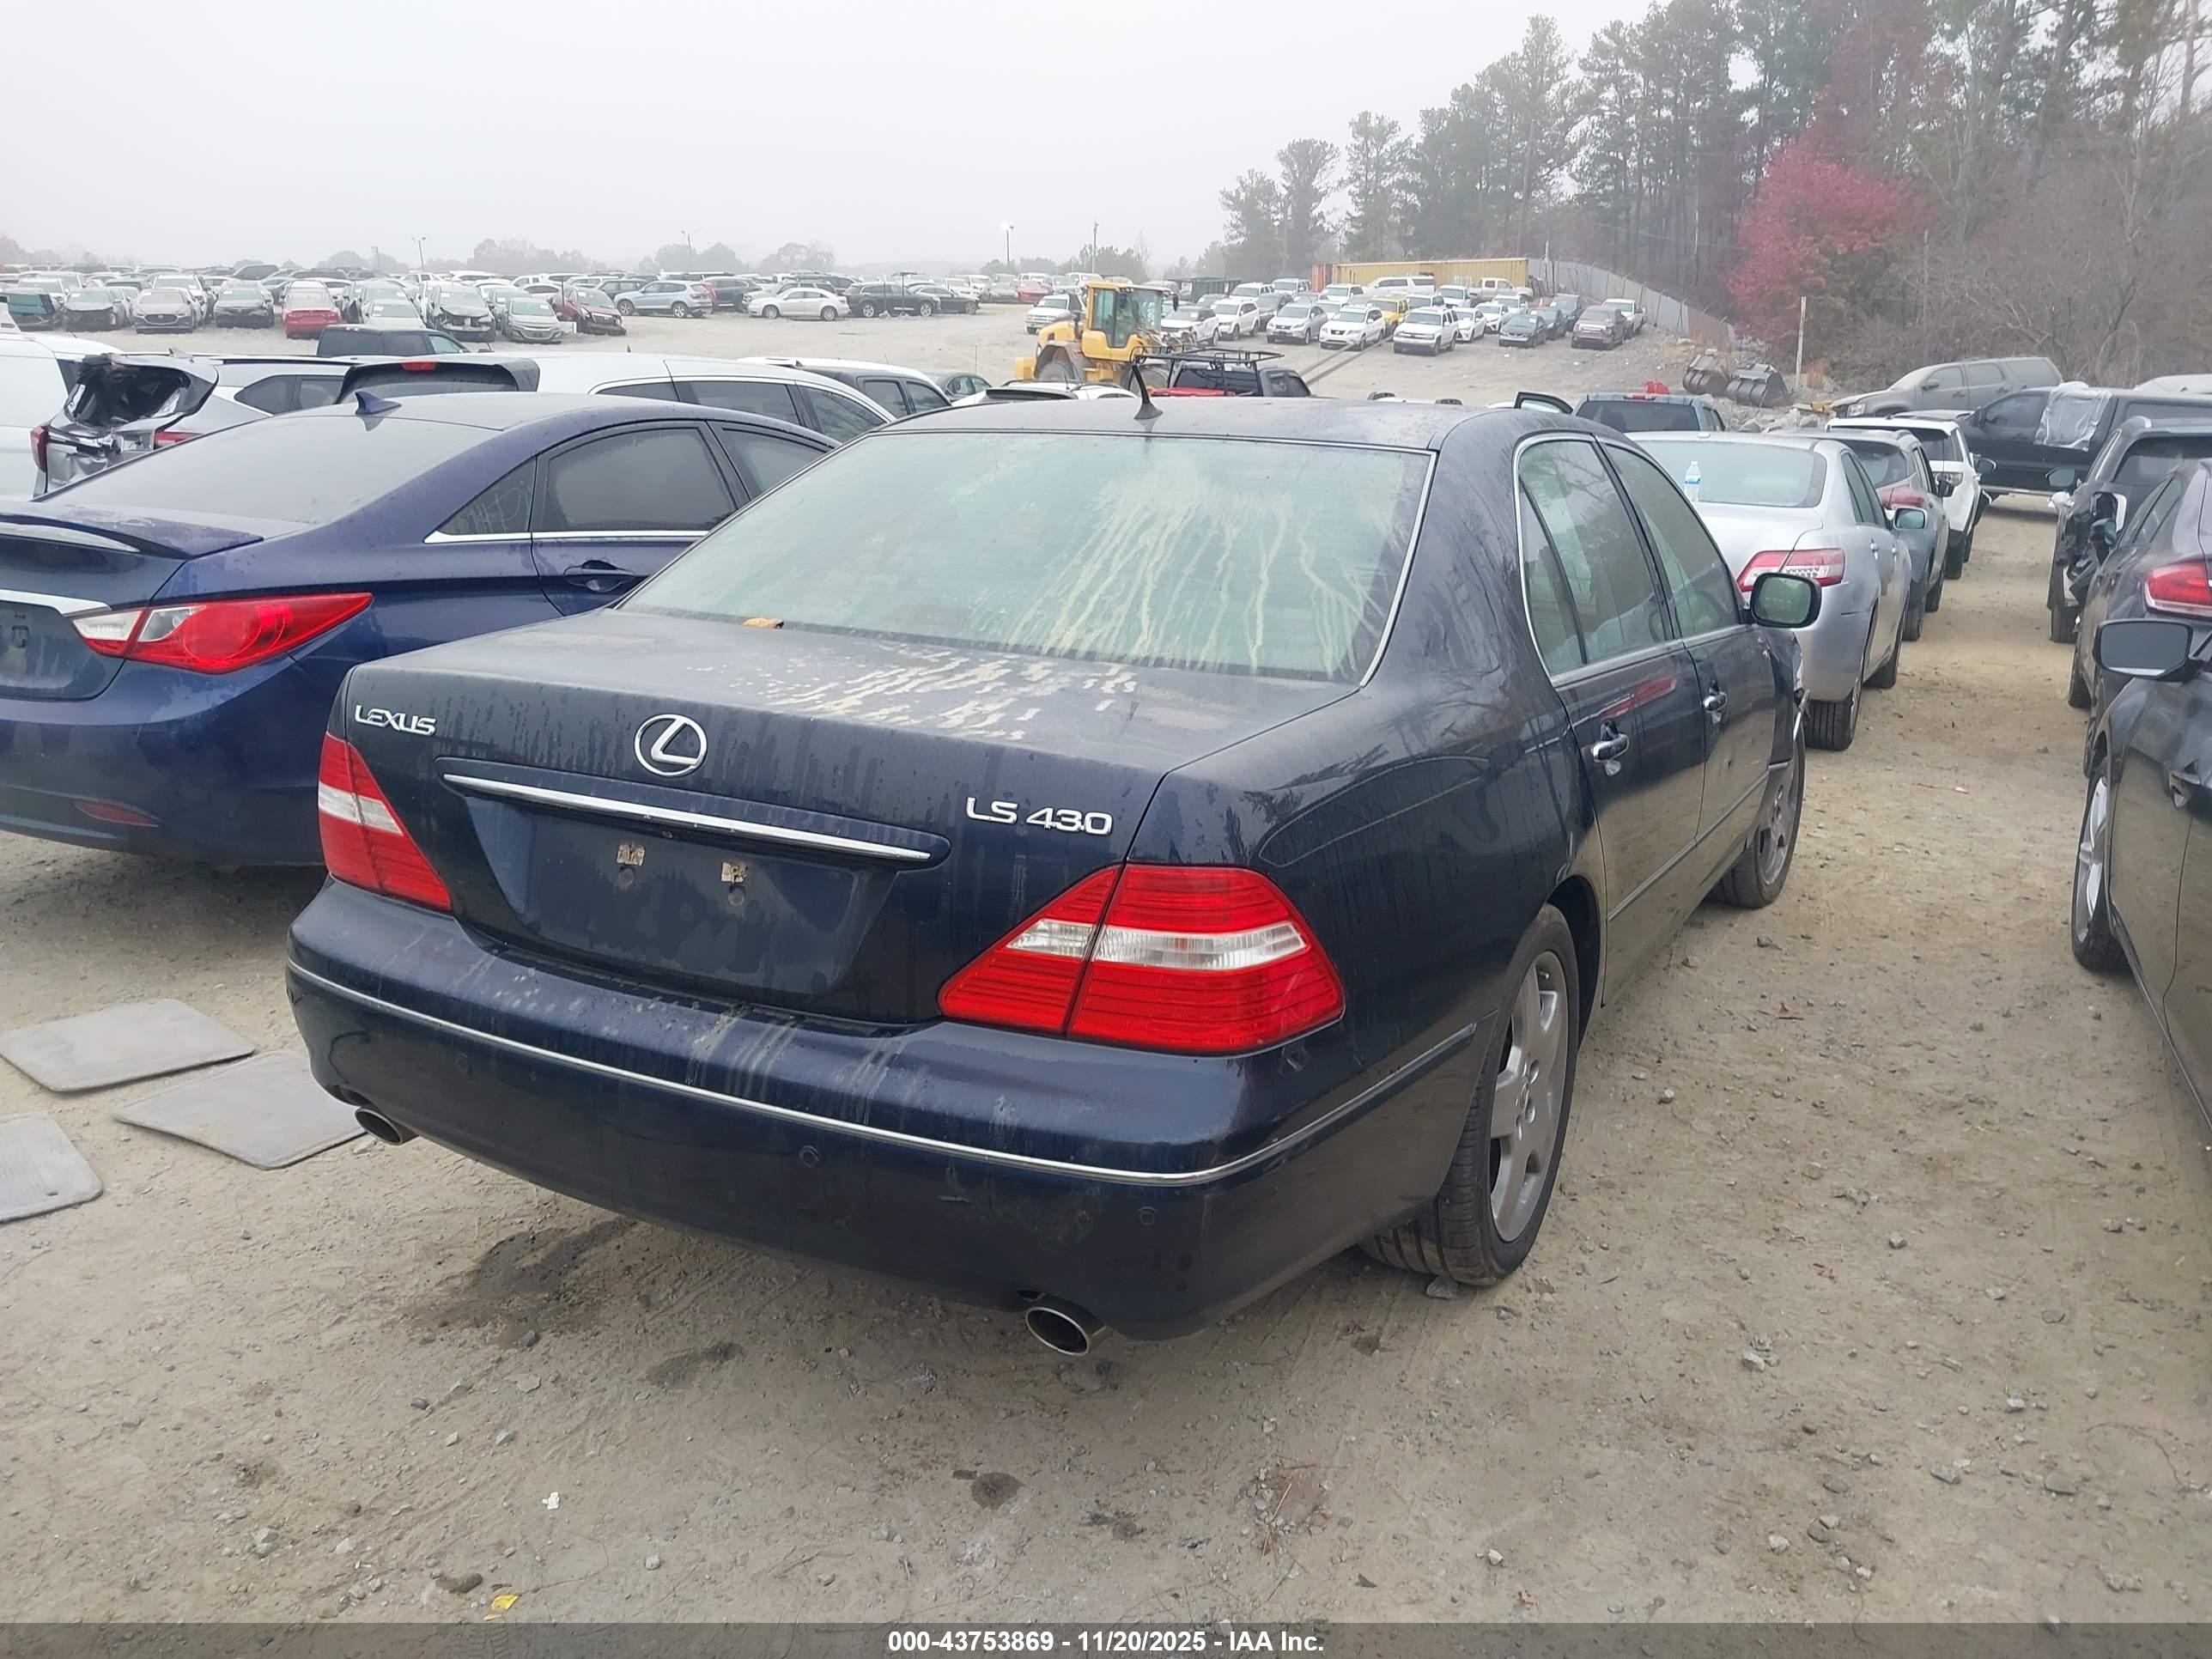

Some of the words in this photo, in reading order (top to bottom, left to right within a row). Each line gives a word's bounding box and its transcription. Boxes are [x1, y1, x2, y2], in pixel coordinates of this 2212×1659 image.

[355, 704, 436, 737] LEXUS
[966, 797, 1018, 824] LS
[1025, 807, 1113, 836] 430
